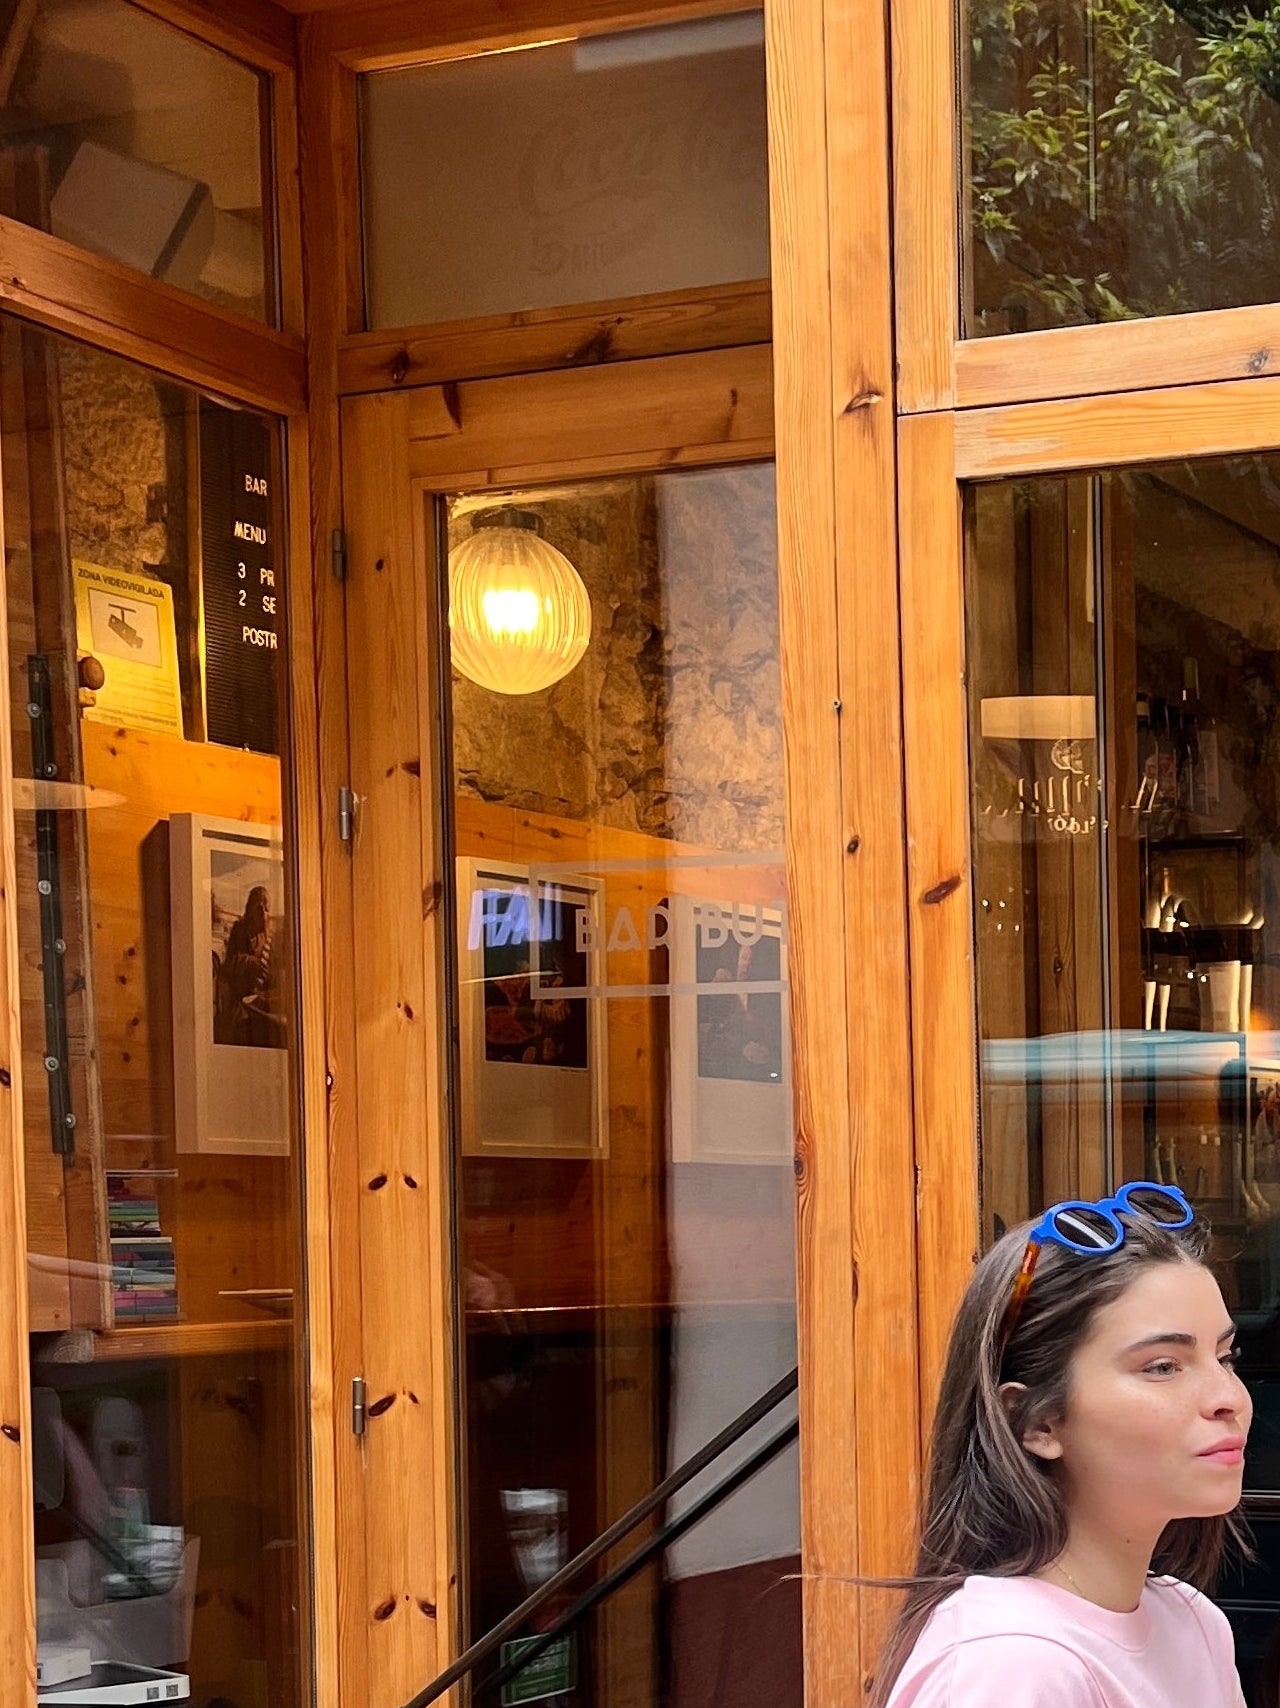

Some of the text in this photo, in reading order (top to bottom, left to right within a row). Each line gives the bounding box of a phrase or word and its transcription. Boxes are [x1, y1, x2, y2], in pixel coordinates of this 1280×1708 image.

[245, 474, 267, 497] BAR
[233, 521, 267, 545] MENU
[237, 562, 246, 579] 3
[238, 590, 247, 607] 2
[241, 625, 278, 650] POSTR
